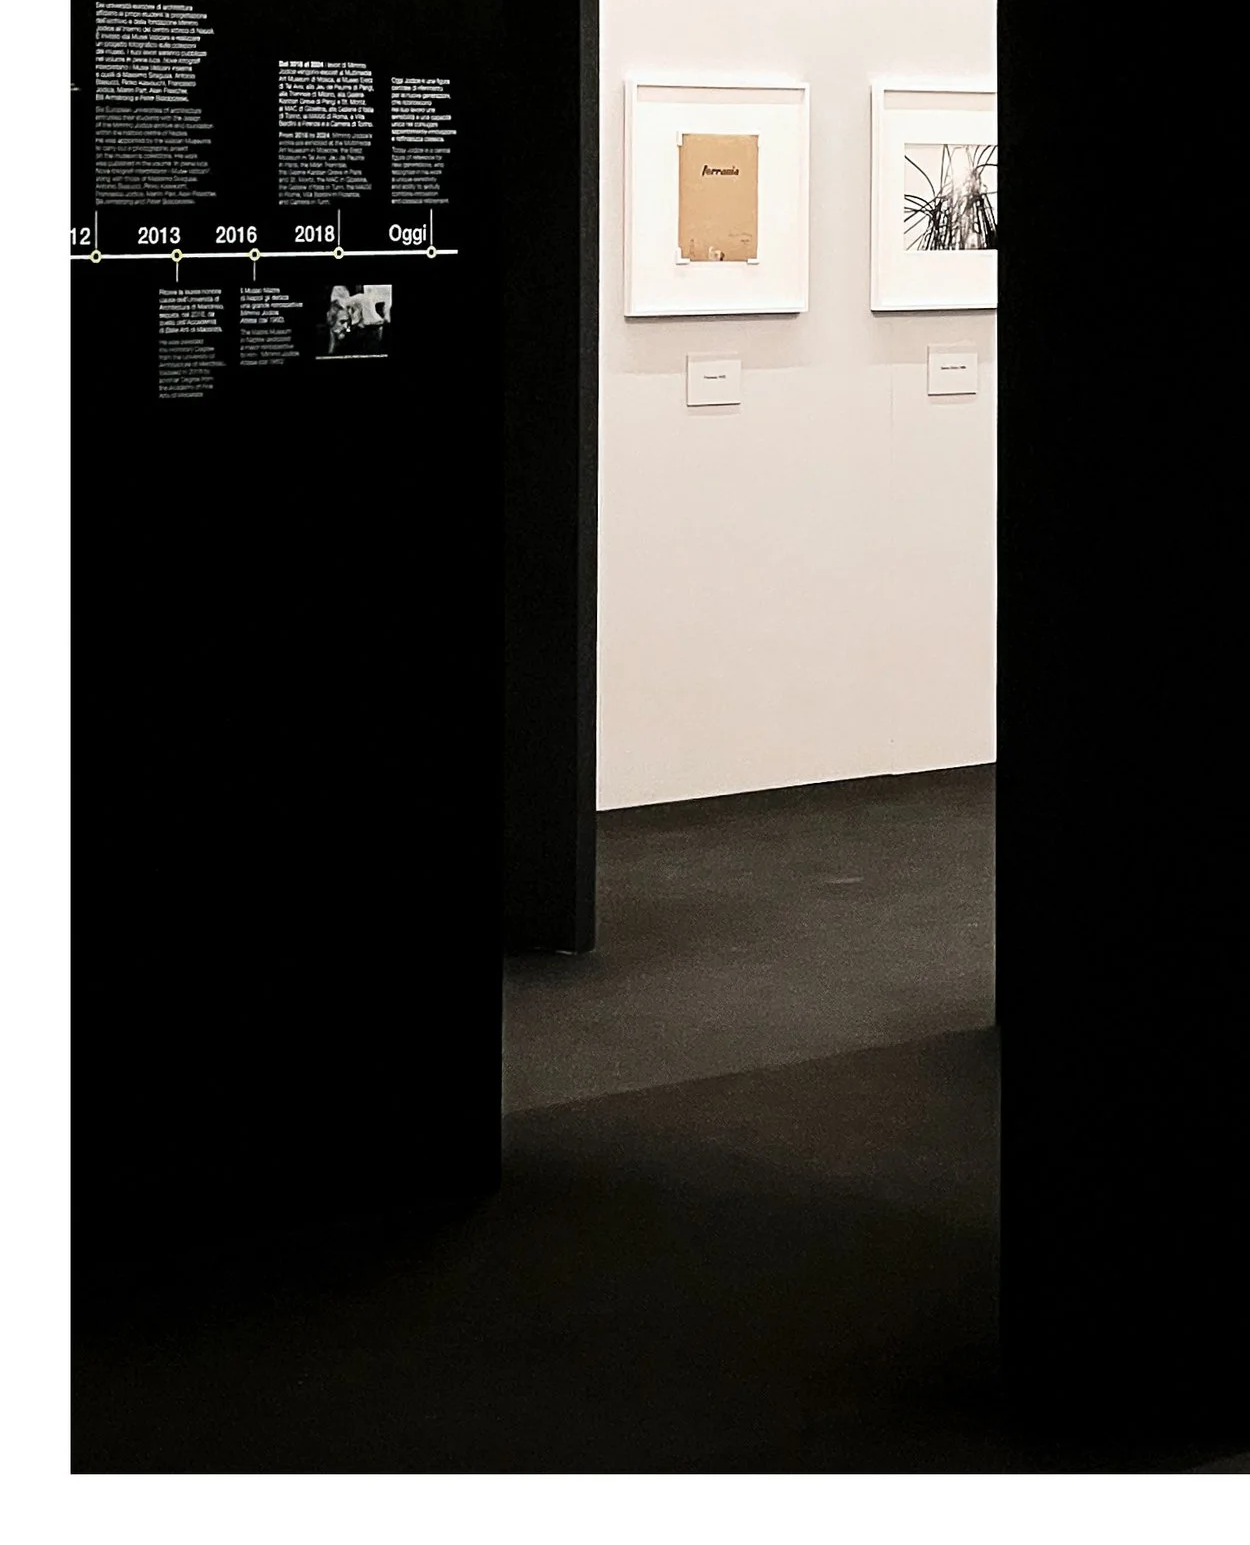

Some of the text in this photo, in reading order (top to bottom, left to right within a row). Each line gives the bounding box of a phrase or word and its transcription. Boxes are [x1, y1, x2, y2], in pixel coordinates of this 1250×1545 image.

[138, 226, 181, 245] 2013
[215, 225, 258, 244] 2016
[294, 224, 336, 243] 2018
[388, 223, 427, 246] Oggi
